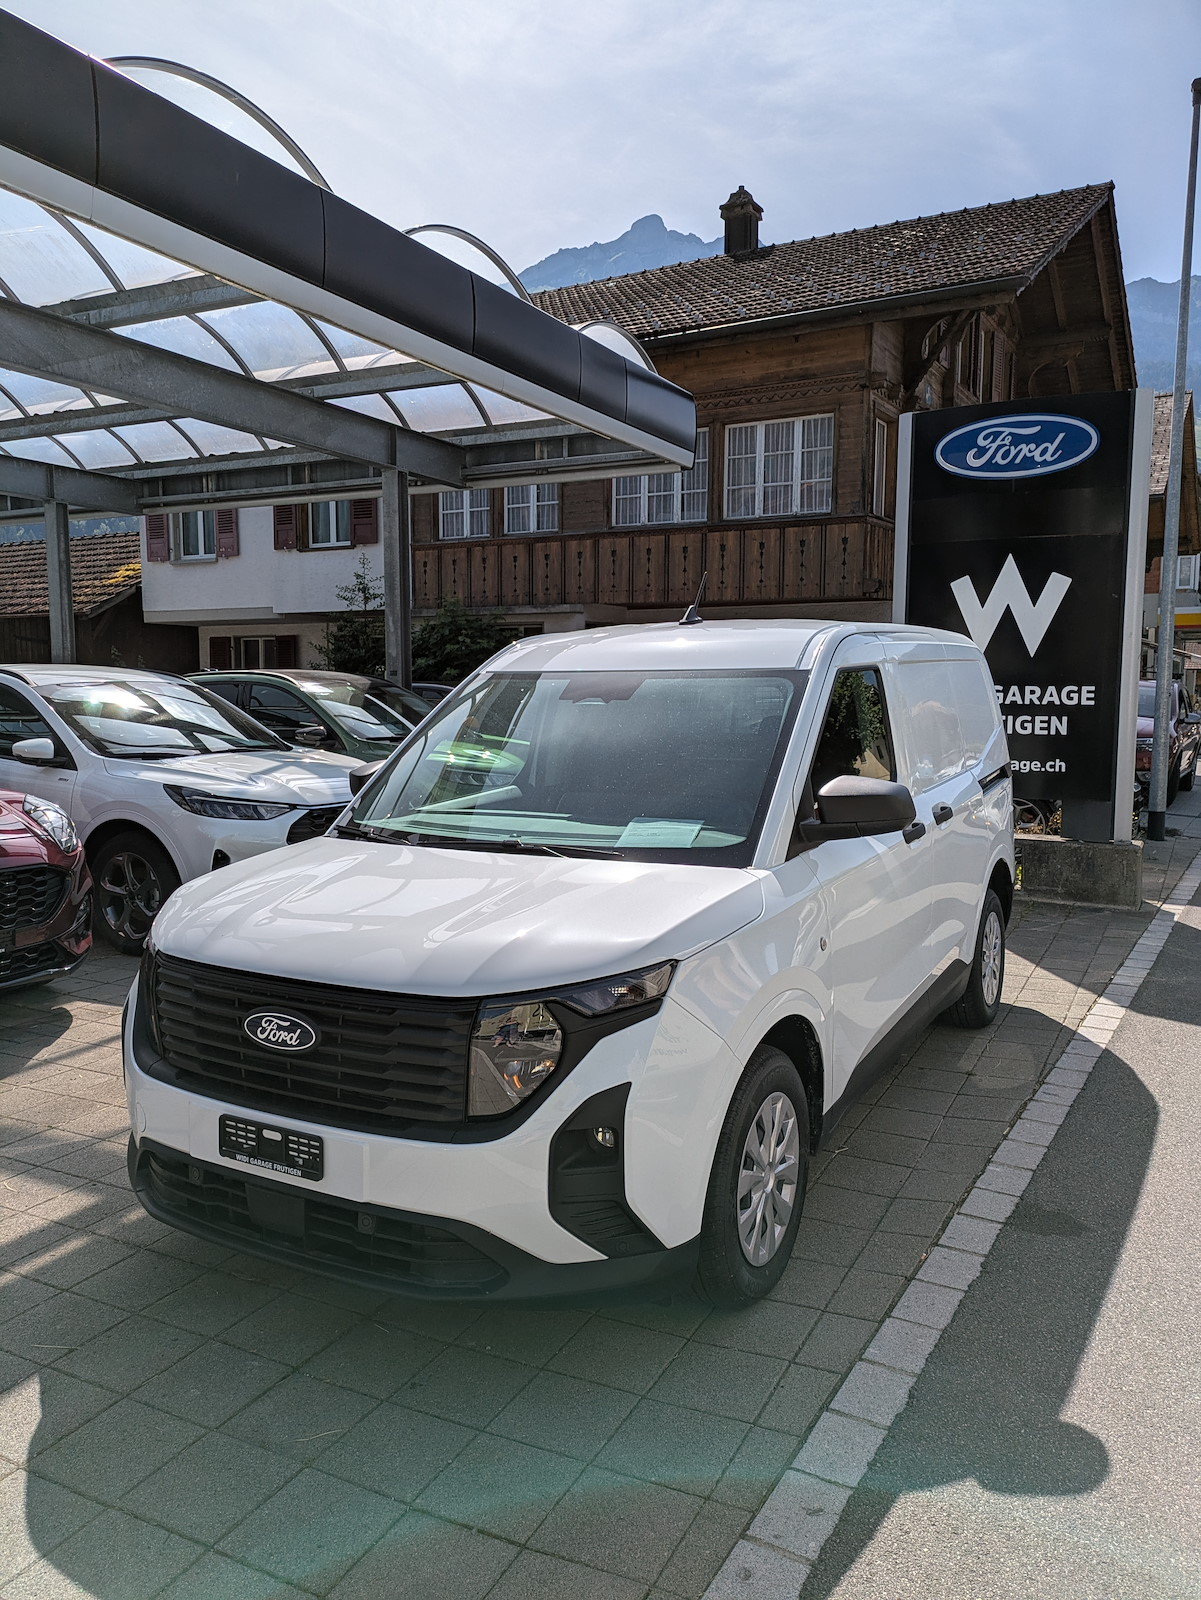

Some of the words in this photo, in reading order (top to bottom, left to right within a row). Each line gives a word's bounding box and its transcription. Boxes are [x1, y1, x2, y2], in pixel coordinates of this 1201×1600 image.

[966, 425, 1066, 468] Ford
[950, 553, 1073, 658] W
[1002, 715, 1068, 736] IGEN
[257, 1017, 301, 1045] Ford
[250, 1157, 273, 1169] GARAGE
[273, 1164, 302, 1176] FRUTIGEN
